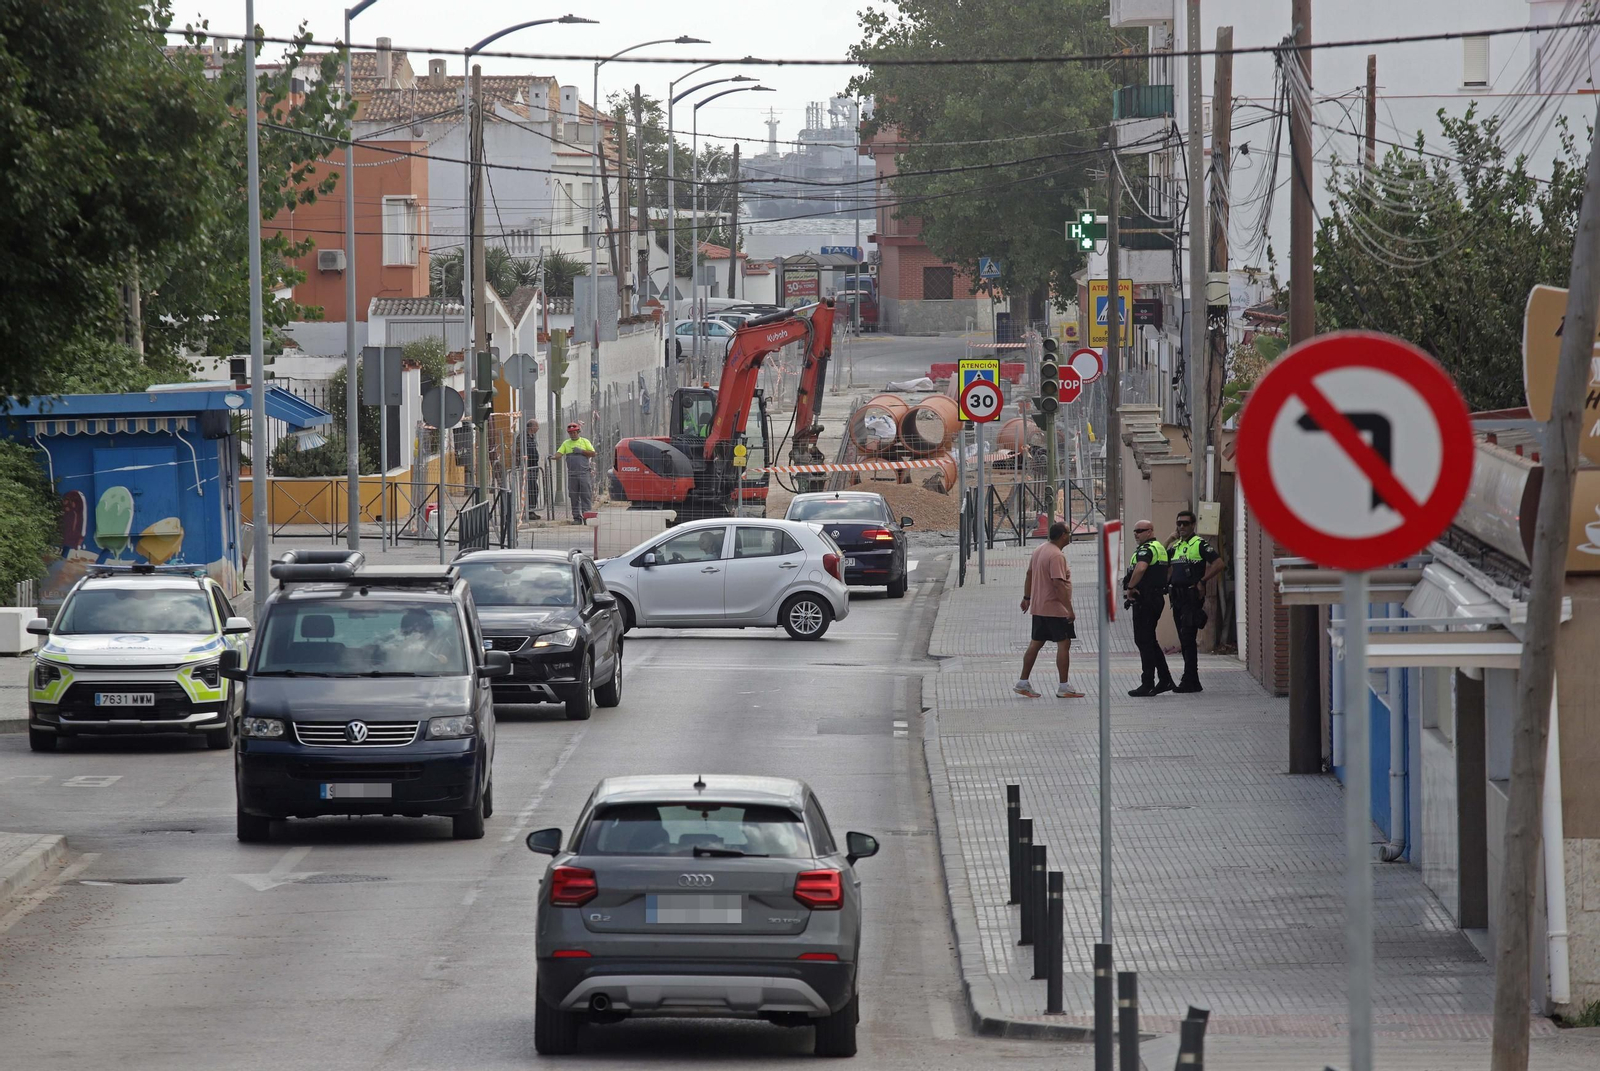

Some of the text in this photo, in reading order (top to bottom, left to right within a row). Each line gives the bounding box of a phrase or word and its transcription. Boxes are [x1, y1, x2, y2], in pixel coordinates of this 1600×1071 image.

[826, 246, 853, 258] TAXI
[1092, 283, 1129, 291] ATEÓN
[767, 330, 788, 342] Kubota
[1059, 380, 1080, 389] TOP
[970, 394, 994, 408] 30
[102, 695, 128, 704] 7631
[590, 913, 611, 921] Q2
